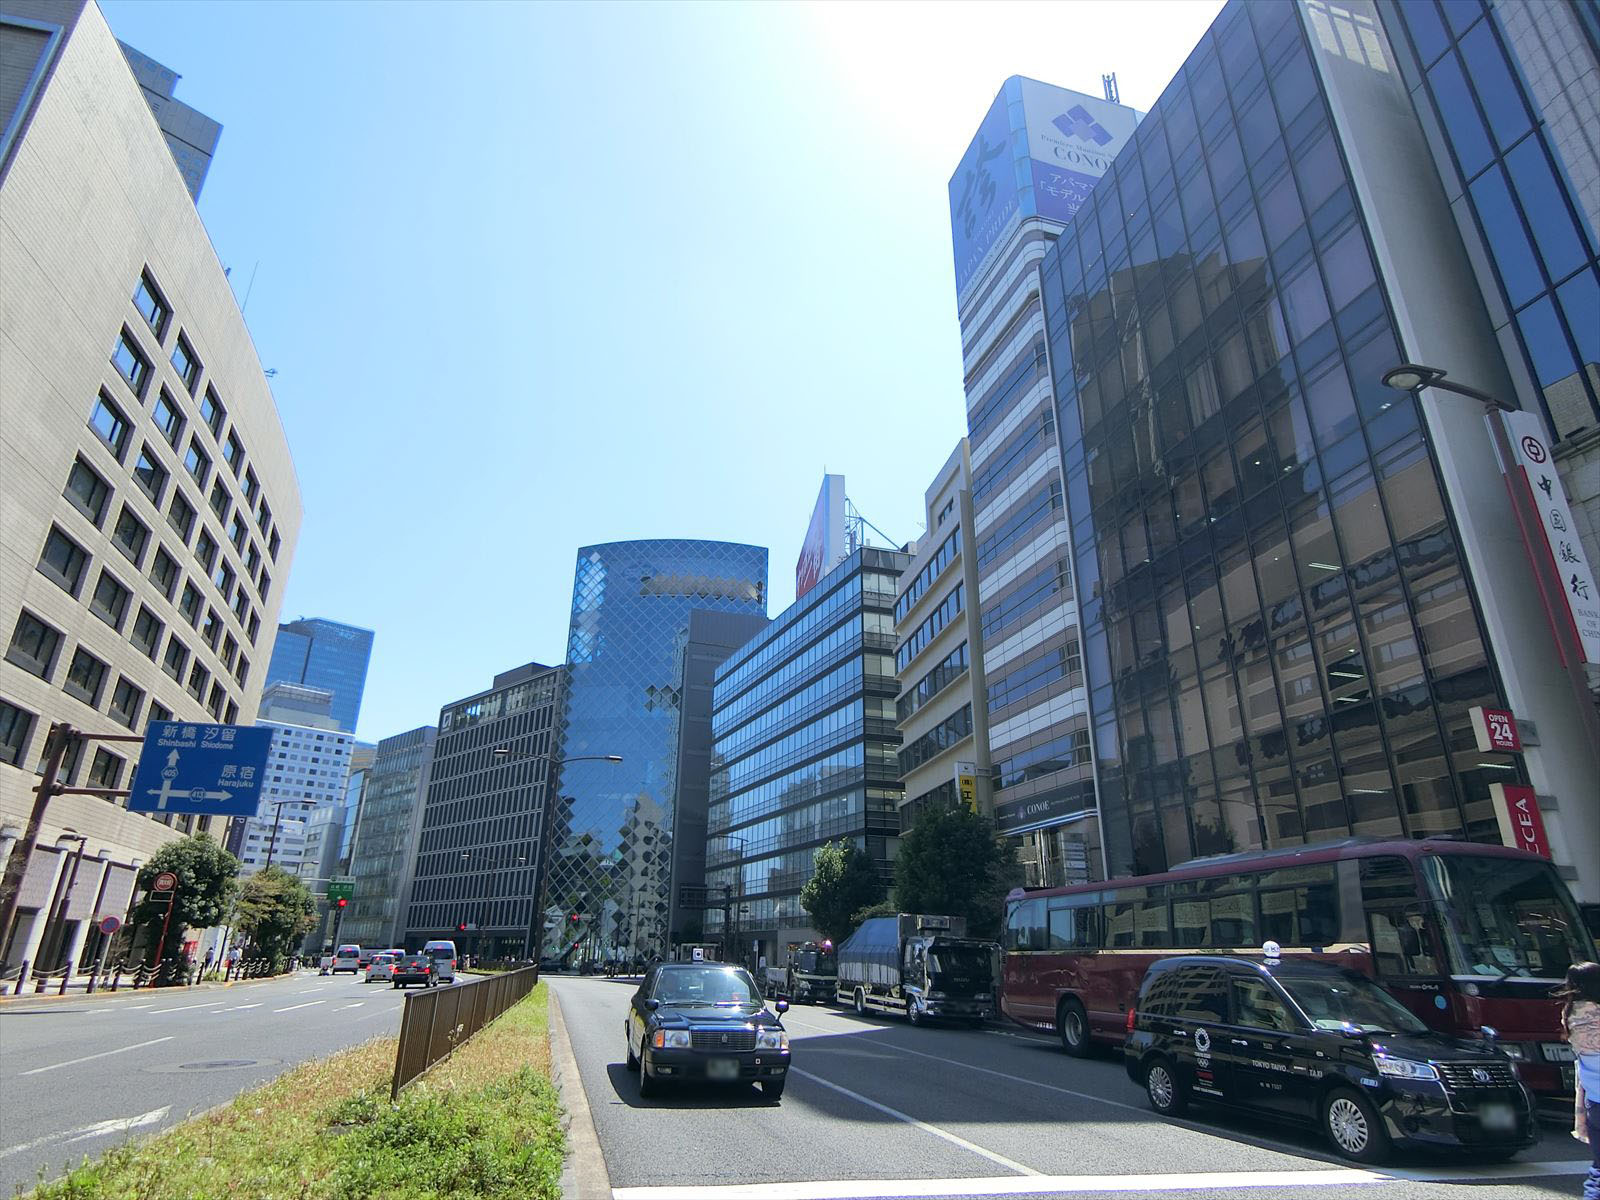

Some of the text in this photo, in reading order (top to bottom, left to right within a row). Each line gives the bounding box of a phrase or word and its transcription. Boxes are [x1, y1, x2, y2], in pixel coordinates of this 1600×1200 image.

[1054, 146, 1112, 170] CONO
[1488, 714, 1508, 723] OPEN
[162, 724, 237, 741] 新橋 汐留
[1490, 722, 1513, 741] 24
[157, 739, 234, 750] Shinbashi Shiodome
[221, 764, 256, 780] 原宿
[217, 779, 254, 788] Harajuku
